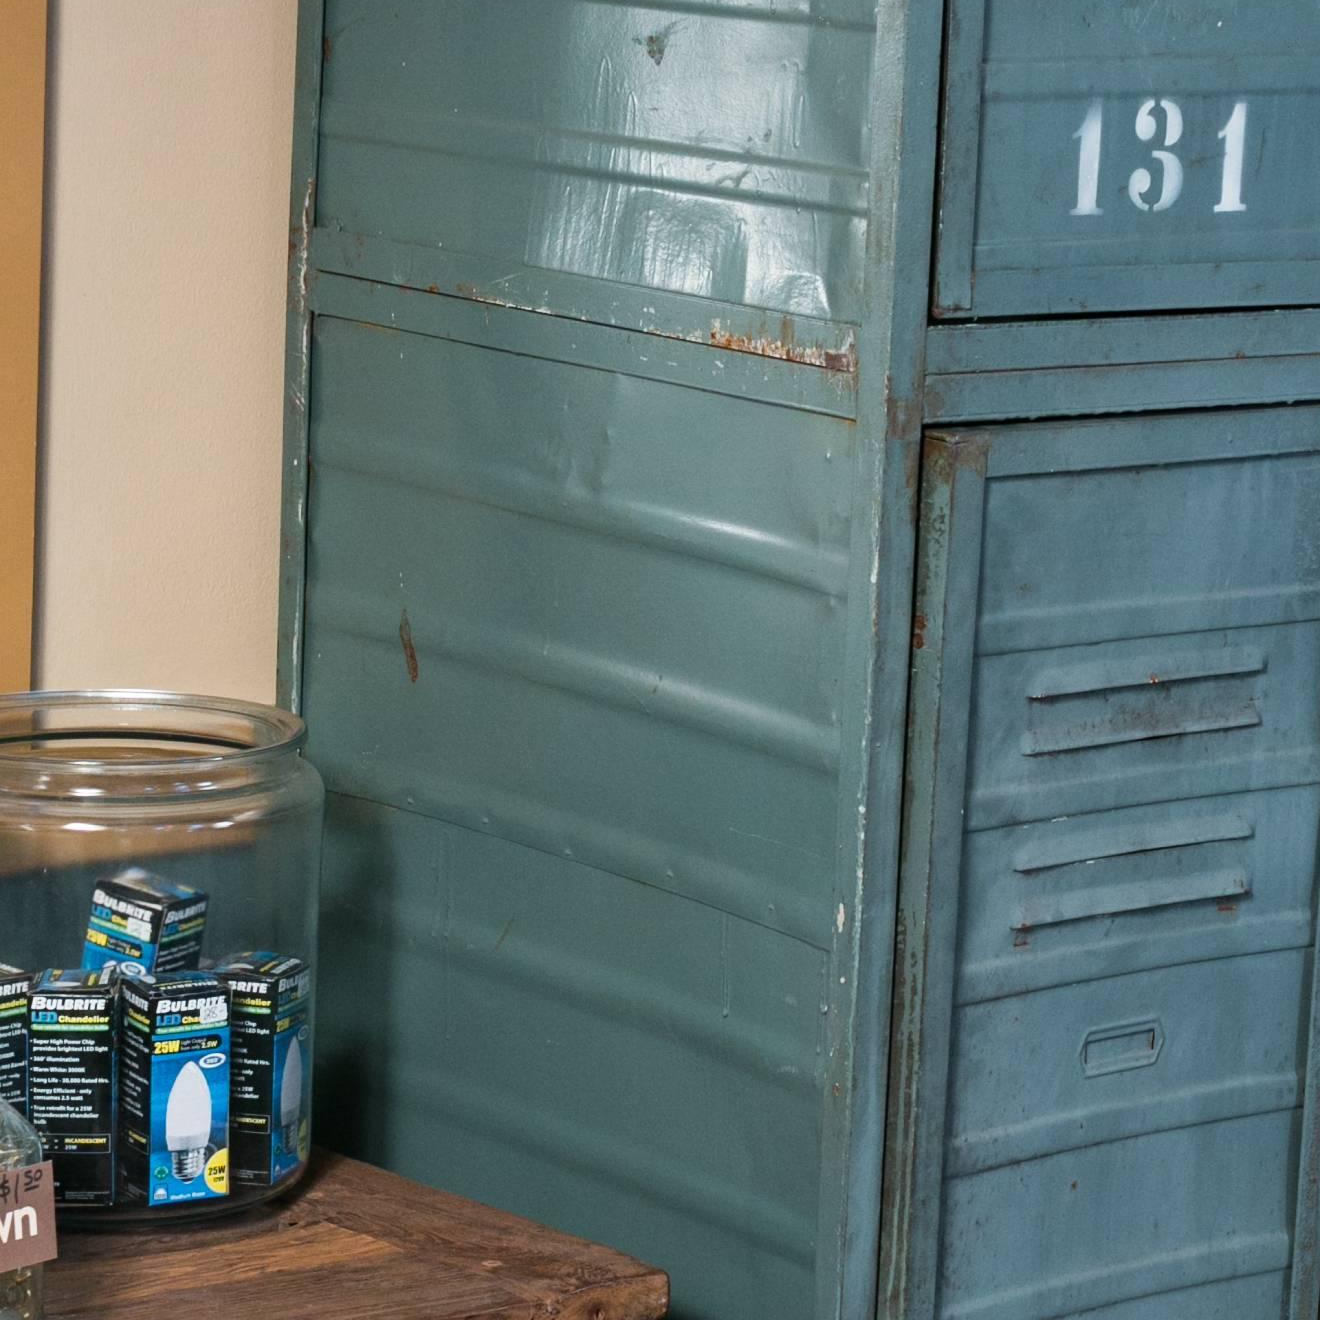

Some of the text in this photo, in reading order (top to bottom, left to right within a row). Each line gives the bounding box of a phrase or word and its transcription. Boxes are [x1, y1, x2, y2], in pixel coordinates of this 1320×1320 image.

[1069, 98, 1247, 215] 131
[31, 996, 106, 1010] BULBRITE
[156, 996, 226, 1014] BULBRITE
[31, 1011, 109, 1023] LED Chandelier
[156, 1014, 181, 1027] LED
[154, 1040, 180, 1054] 25W
[208, 1166, 225, 1176] 25W
